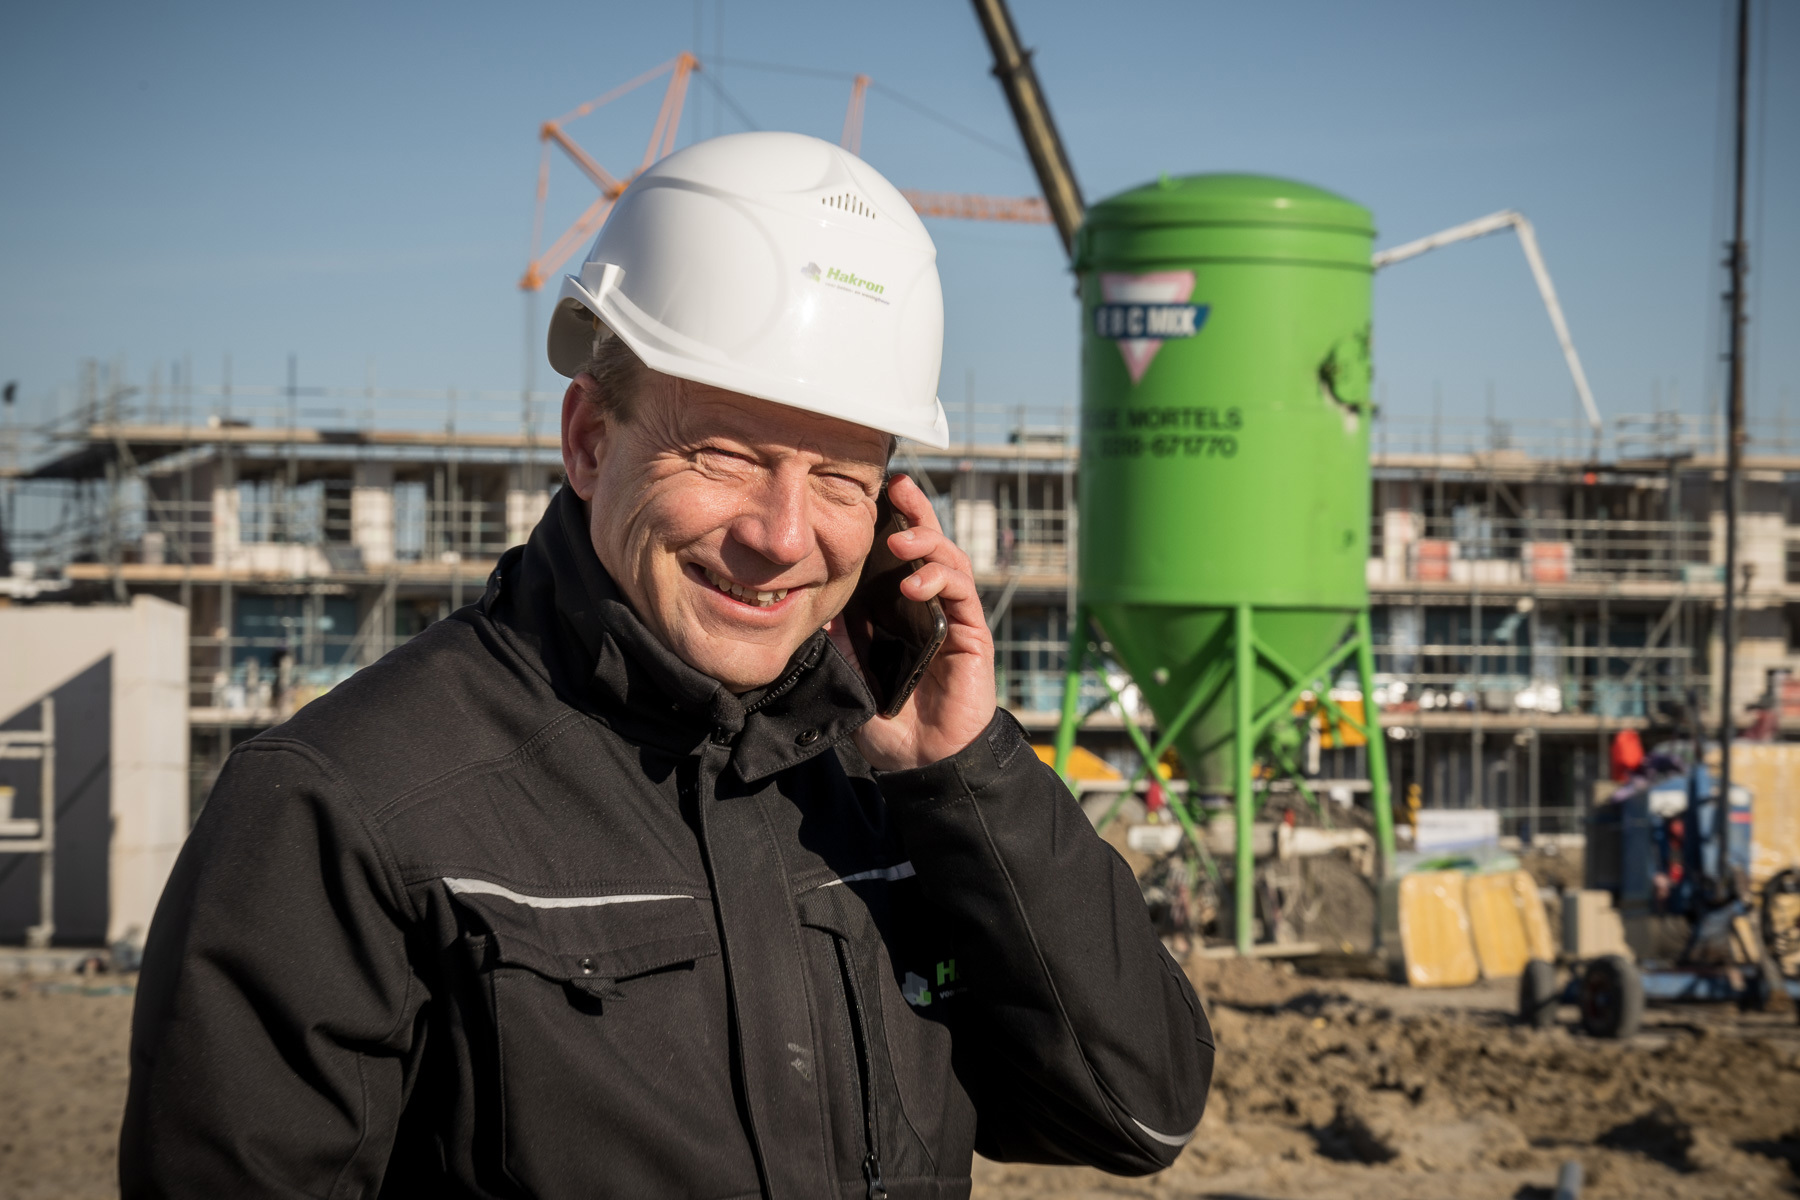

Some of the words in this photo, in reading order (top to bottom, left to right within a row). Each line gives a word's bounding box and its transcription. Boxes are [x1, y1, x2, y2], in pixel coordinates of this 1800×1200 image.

[826, 267, 884, 294] Hakron
[1147, 306, 1197, 336] MIX
[1127, 407, 1243, 430] MORTELS
